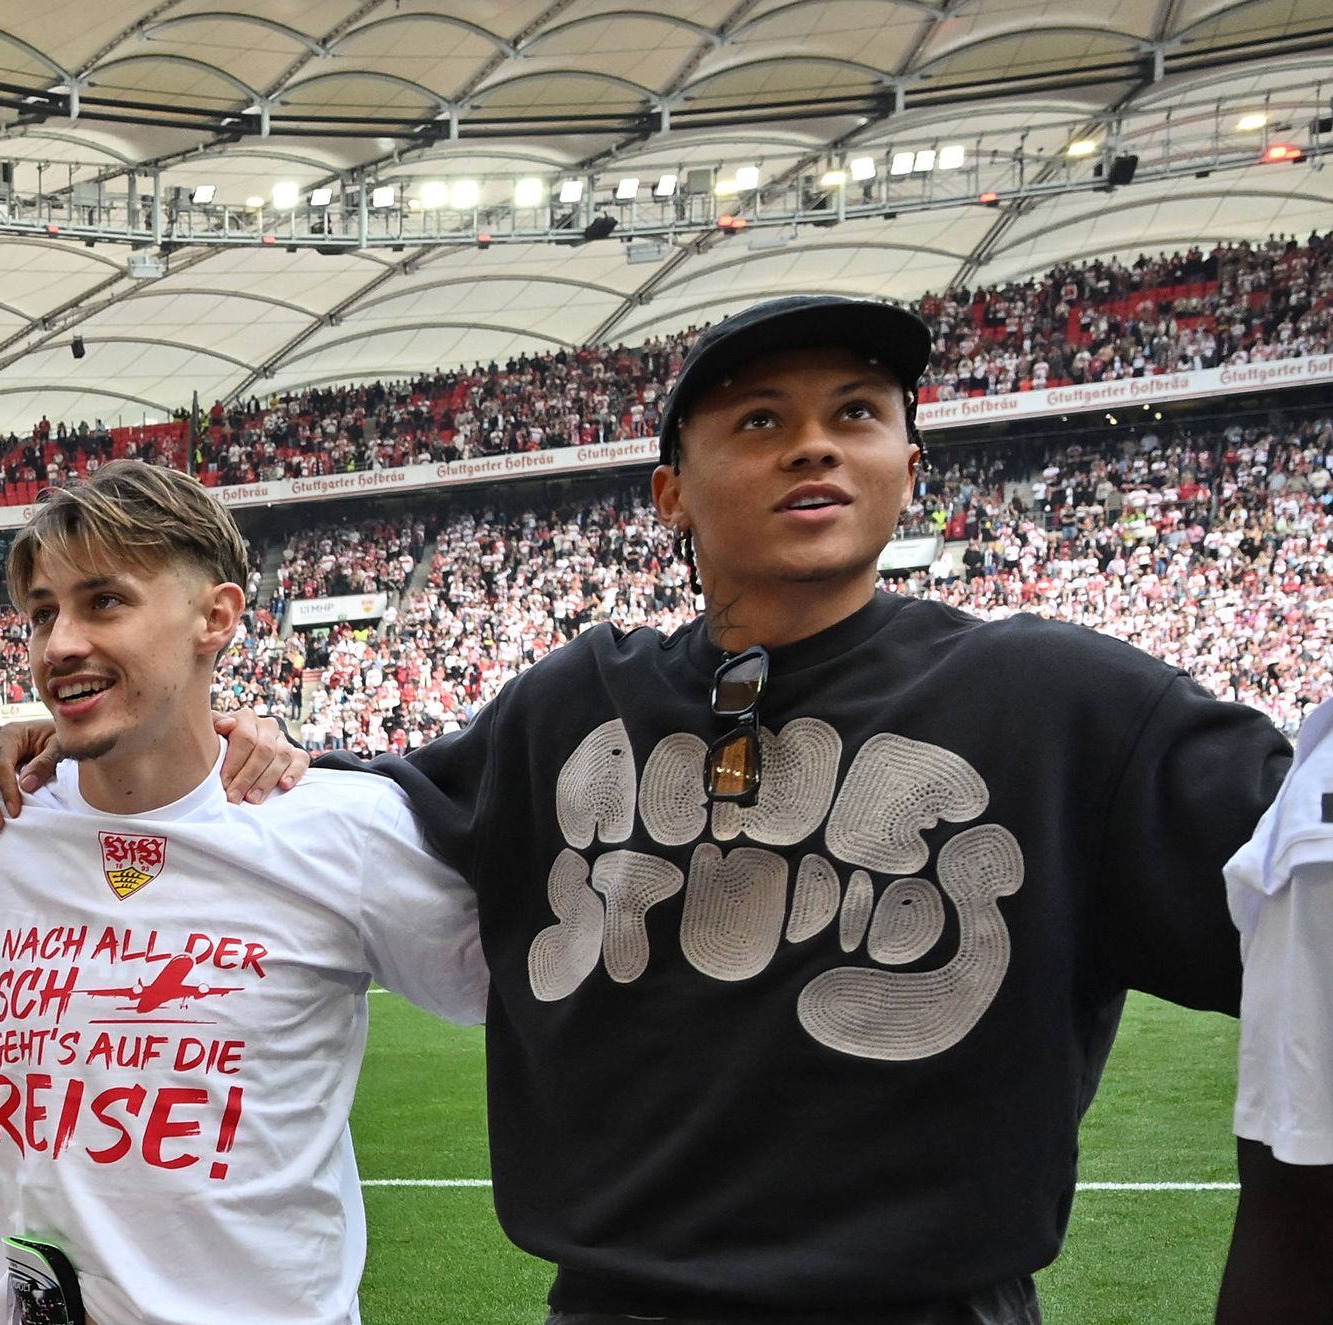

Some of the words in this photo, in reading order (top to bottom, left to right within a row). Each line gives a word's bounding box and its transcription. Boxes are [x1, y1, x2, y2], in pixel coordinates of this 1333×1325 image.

[918, 404, 958, 422] garter
[2, 926, 87, 962] NACH
[92, 927, 172, 964] ALL
[185, 933, 268, 978] DER
[86, 1032, 168, 1070] AUF
[174, 1038, 245, 1074] DIE
